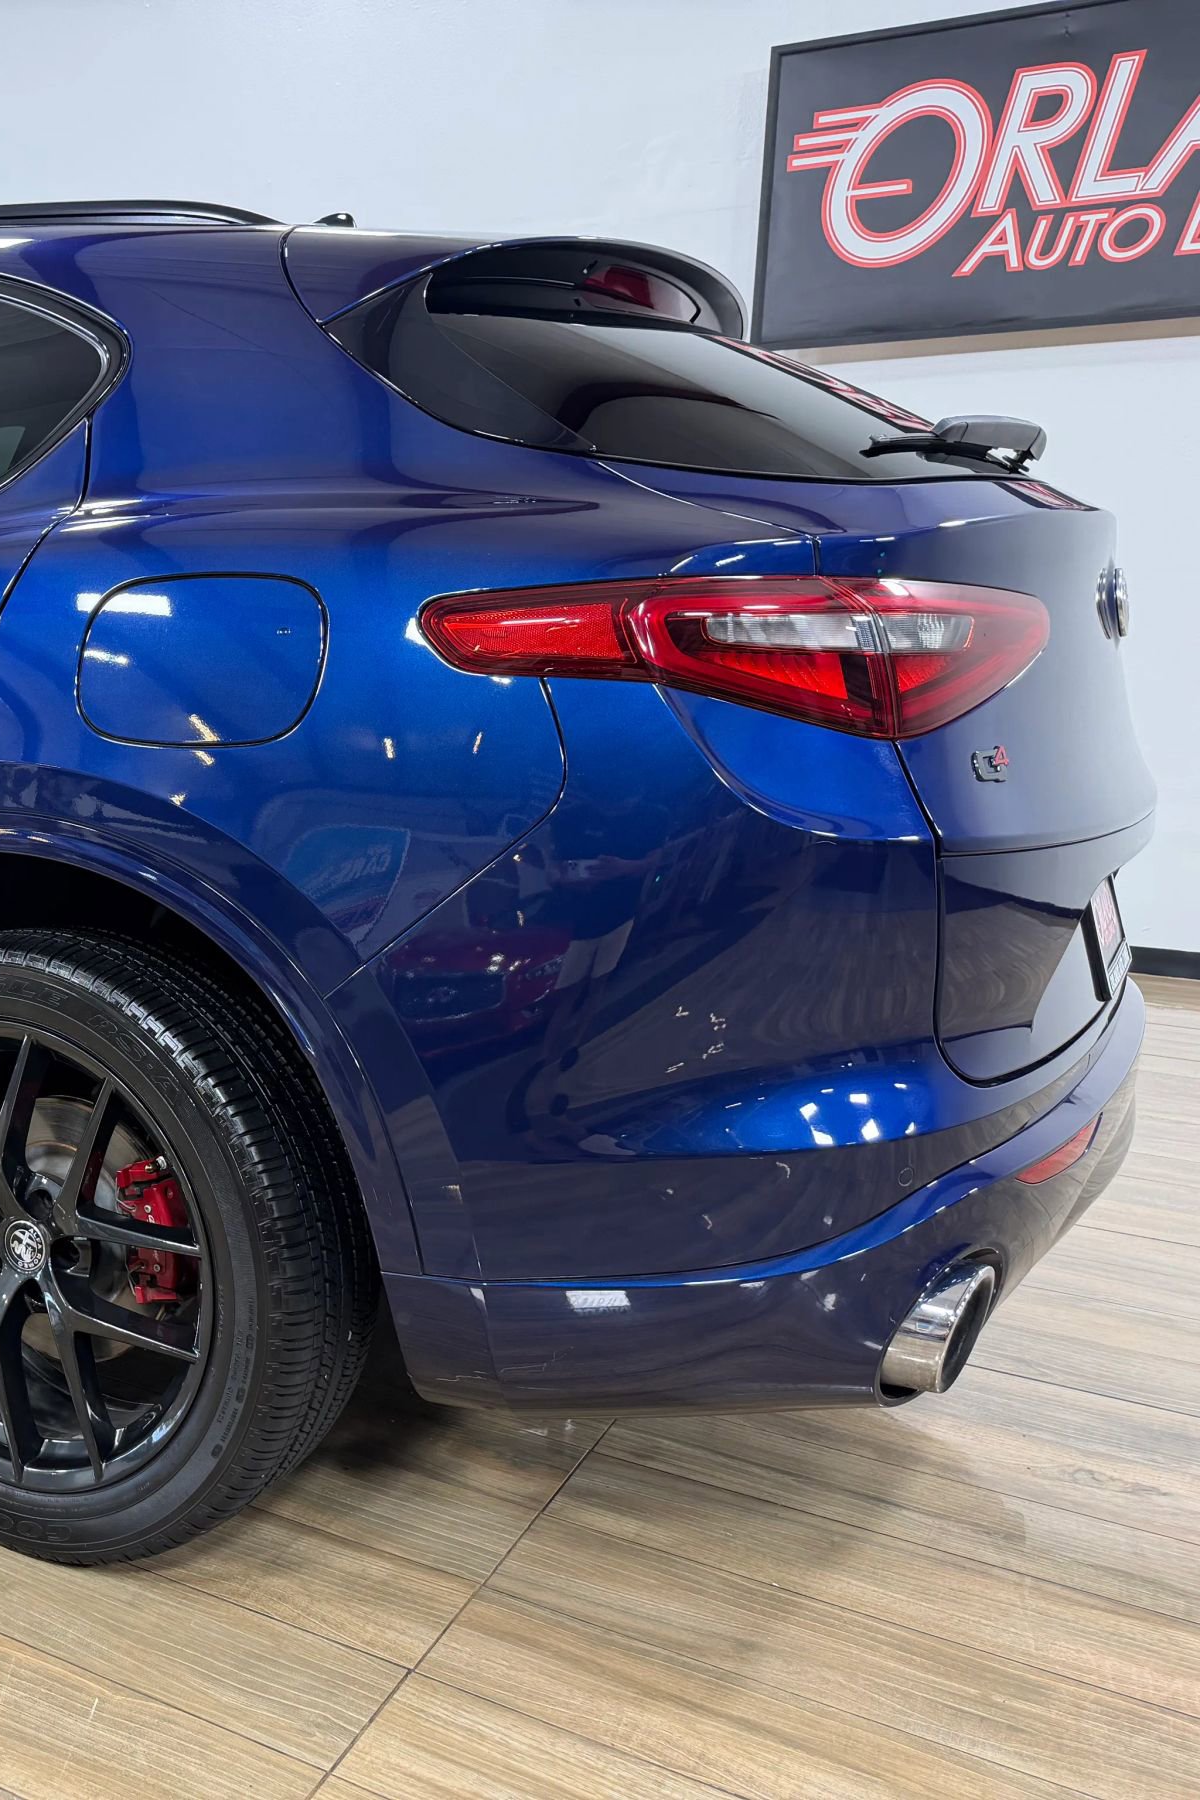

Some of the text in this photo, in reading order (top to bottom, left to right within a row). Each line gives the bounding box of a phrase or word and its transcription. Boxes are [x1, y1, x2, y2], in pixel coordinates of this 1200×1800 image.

[951, 203, 1166, 277] AUTO
[28, 1228, 43, 1250] ALFA
[18, 1253, 42, 1268] ROMEO
